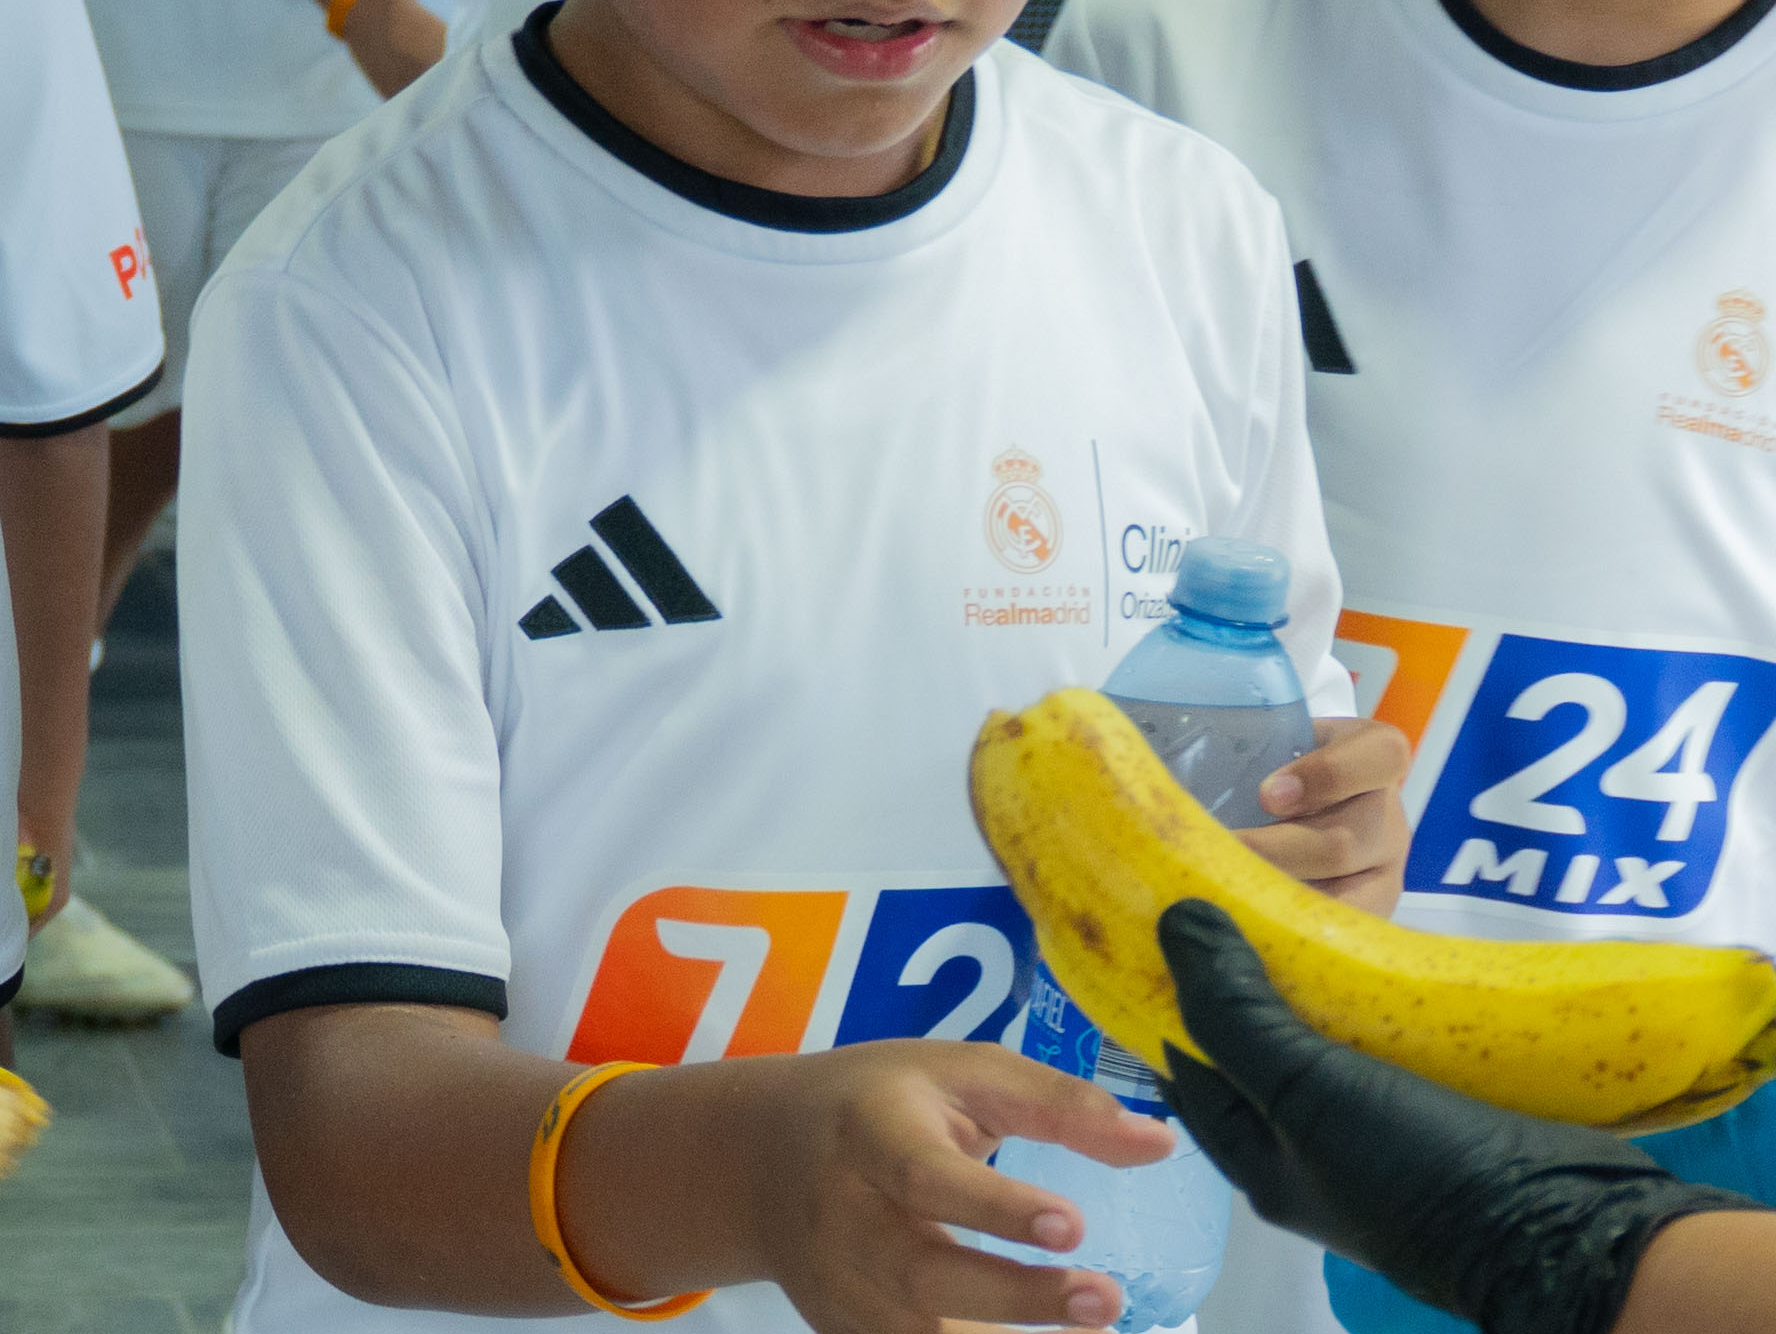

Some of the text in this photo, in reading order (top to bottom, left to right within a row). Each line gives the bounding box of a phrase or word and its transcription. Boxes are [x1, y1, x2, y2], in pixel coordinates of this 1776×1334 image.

[964, 602, 1091, 627] Realmadrid
[1470, 672, 1740, 843] 24
[1440, 838, 1688, 909] MIX
